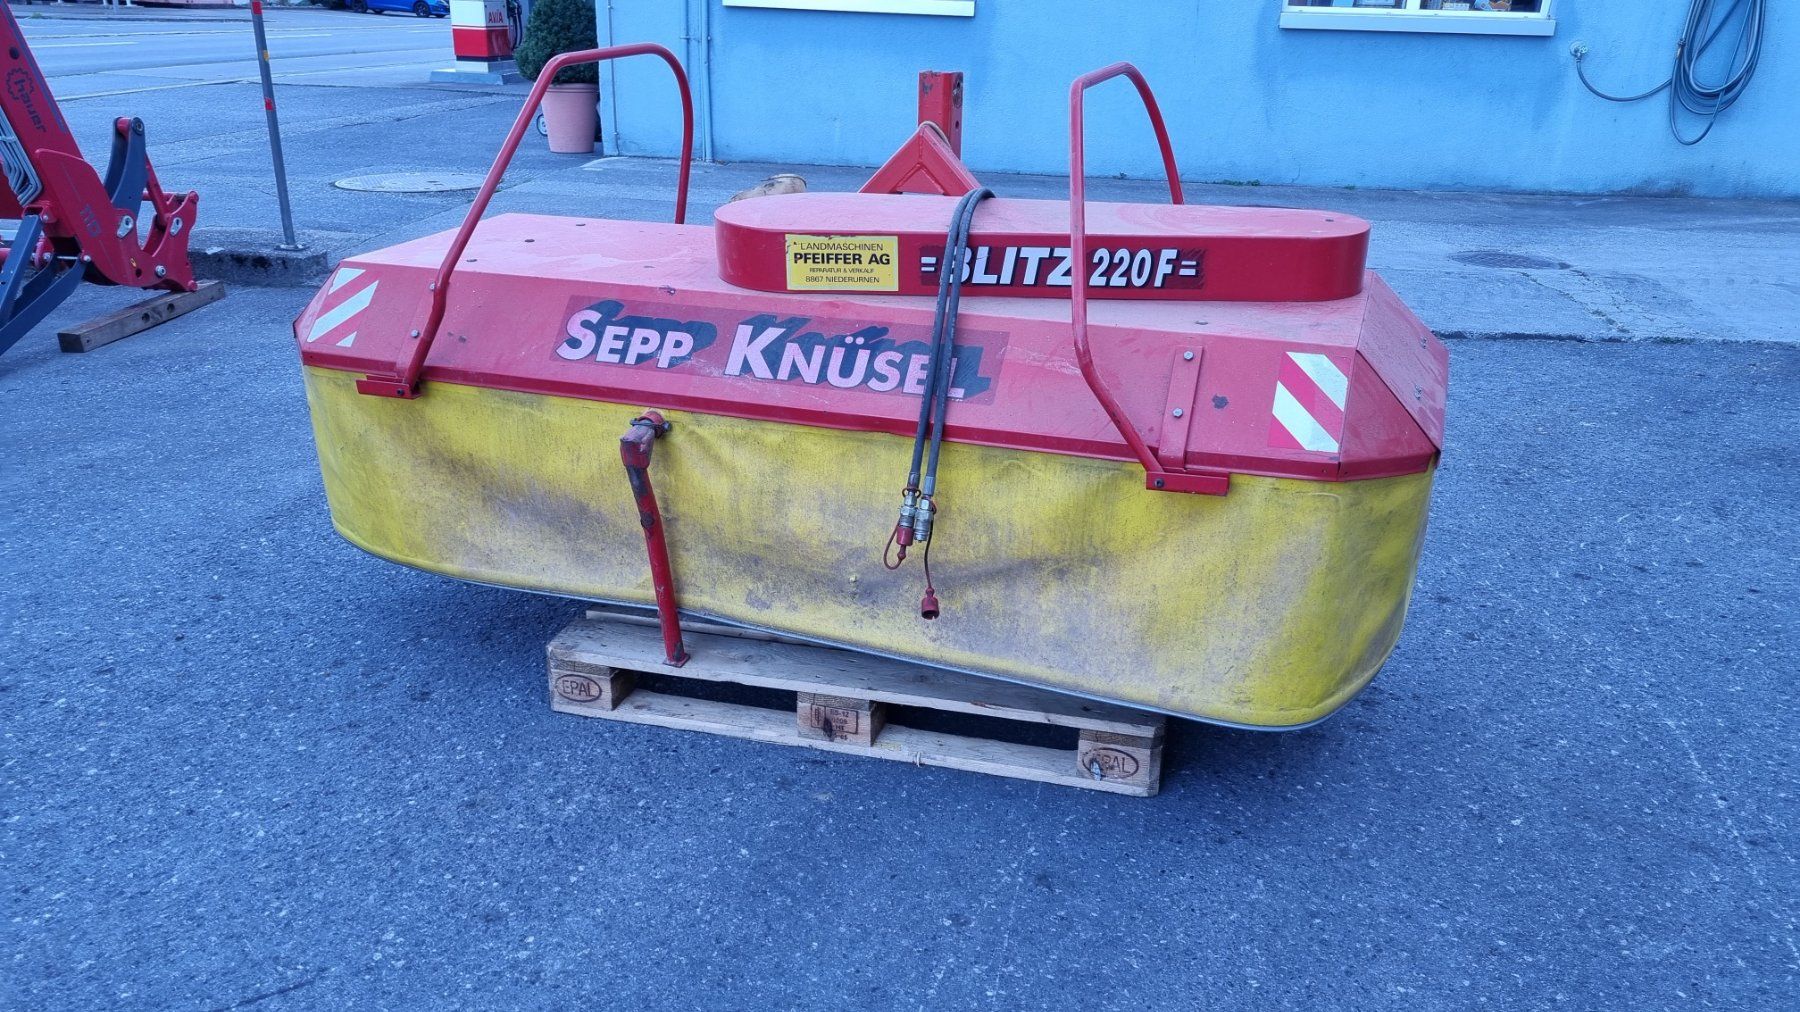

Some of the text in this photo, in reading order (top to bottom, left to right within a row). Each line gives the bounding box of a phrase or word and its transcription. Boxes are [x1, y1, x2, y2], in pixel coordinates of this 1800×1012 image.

[488, 11, 504, 23] AVIA
[800, 242, 884, 251] LANDMASCHINEN
[793, 252, 891, 265] PFEIFFER AG
[825, 275, 880, 283] NIEDERURNEN
[555, 308, 695, 369] SEPP
[562, 679, 596, 698] EPAL
